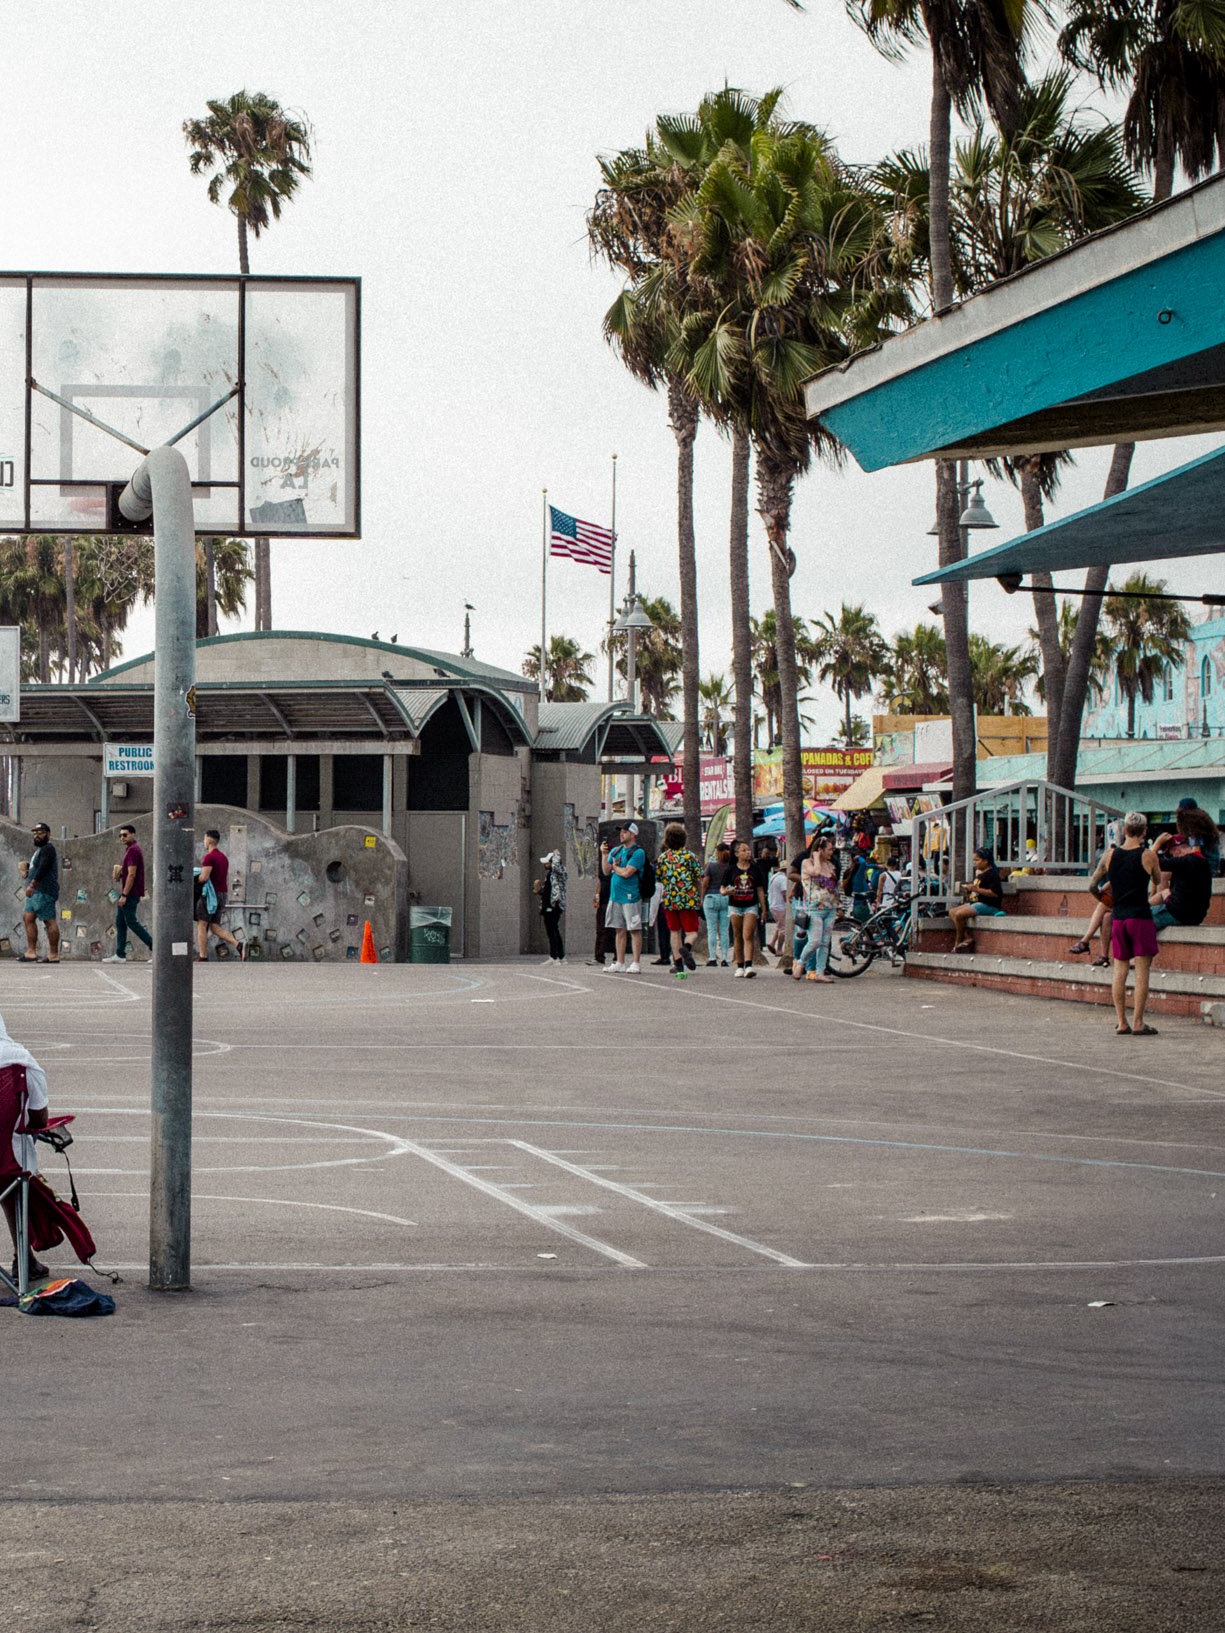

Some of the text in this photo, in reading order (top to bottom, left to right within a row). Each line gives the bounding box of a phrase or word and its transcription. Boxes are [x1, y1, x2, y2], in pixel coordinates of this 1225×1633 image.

[118, 747, 152, 758] PUBLIC
[801, 751, 843, 766] PANADAS
[845, 754, 852, 767] &
